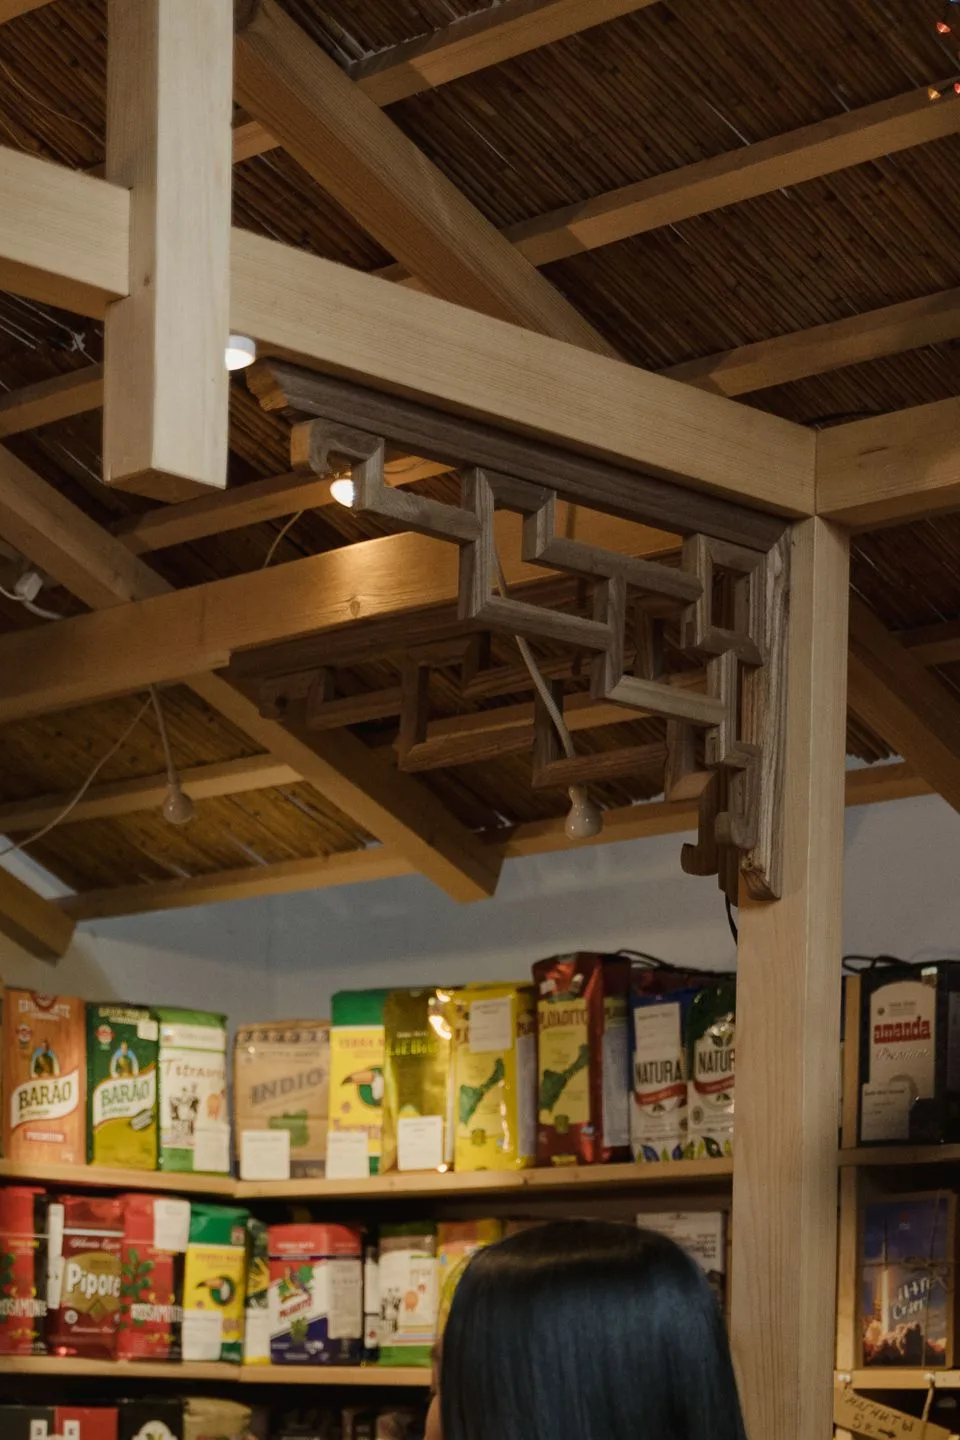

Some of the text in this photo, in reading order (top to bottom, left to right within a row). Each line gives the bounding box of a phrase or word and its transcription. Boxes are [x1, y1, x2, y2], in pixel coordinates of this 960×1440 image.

[874, 1016, 931, 1044] amanda
[635, 1060, 682, 1084] NATURA
[698, 1048, 735, 1074] NATUR
[19, 1080, 72, 1111] BARÃO
[101, 1081, 150, 1106] BARÃO
[251, 1066, 326, 1106] INDIO
